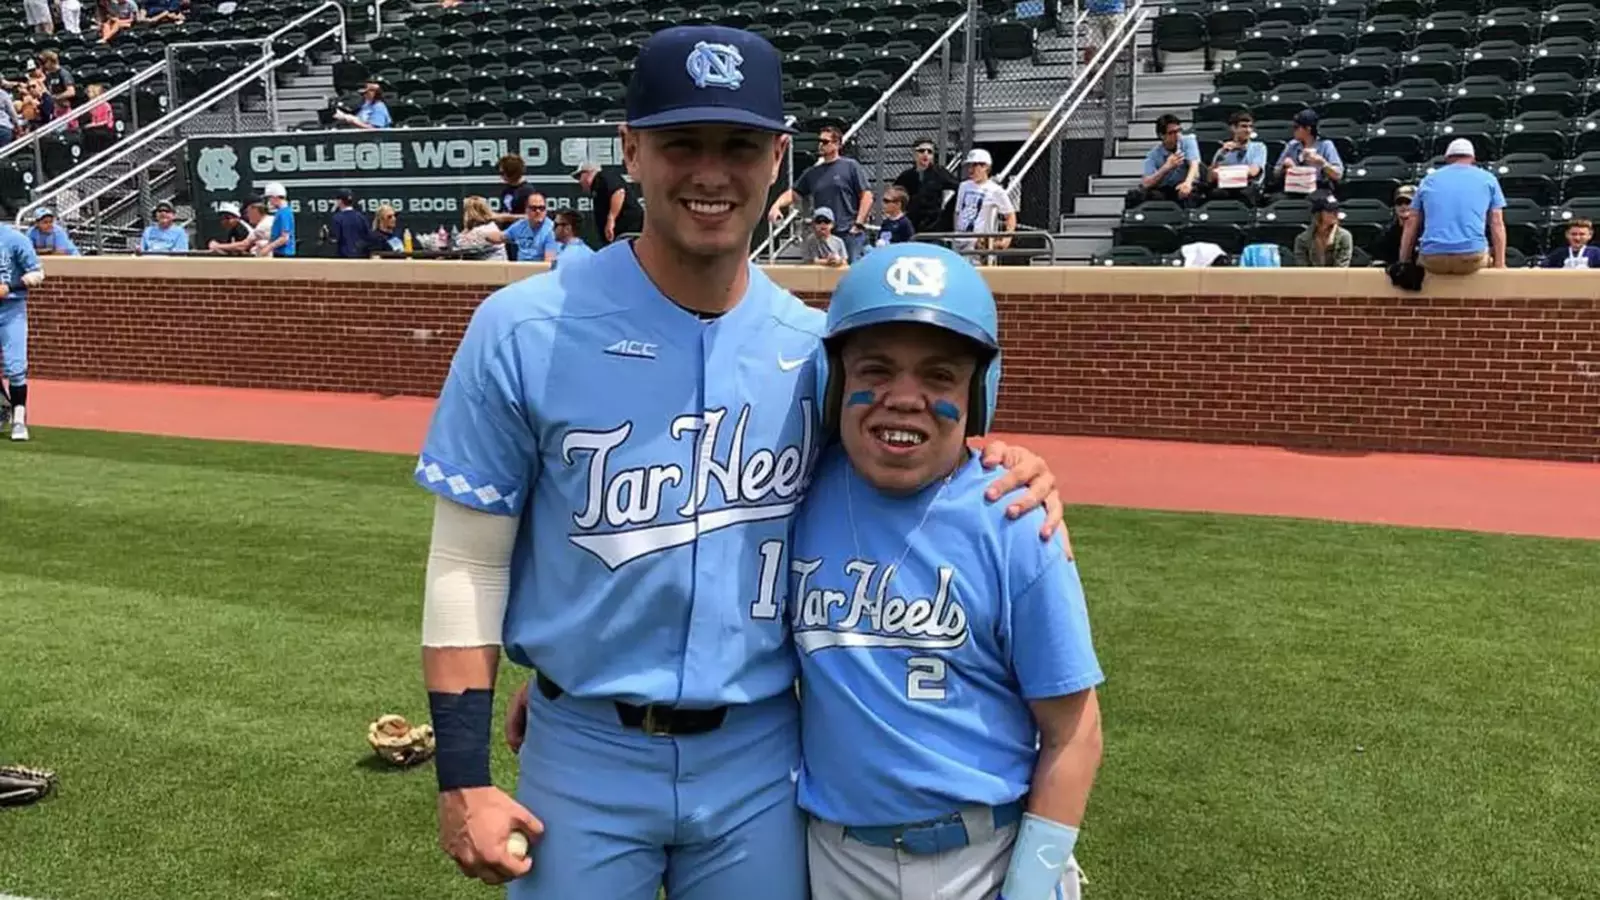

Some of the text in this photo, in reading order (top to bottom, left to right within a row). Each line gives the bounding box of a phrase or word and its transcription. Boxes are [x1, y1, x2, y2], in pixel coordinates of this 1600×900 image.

[250, 141, 403, 173] COLLEGE
[560, 137, 624, 167] SE
[307, 199, 338, 213] 197
[409, 198, 457, 212] 2006
[605, 339, 658, 357] ACC
[562, 397, 814, 530] Tar Heel
[750, 539, 786, 621] 1
[790, 557, 968, 639] Tar Heels
[906, 656, 947, 700] 2
